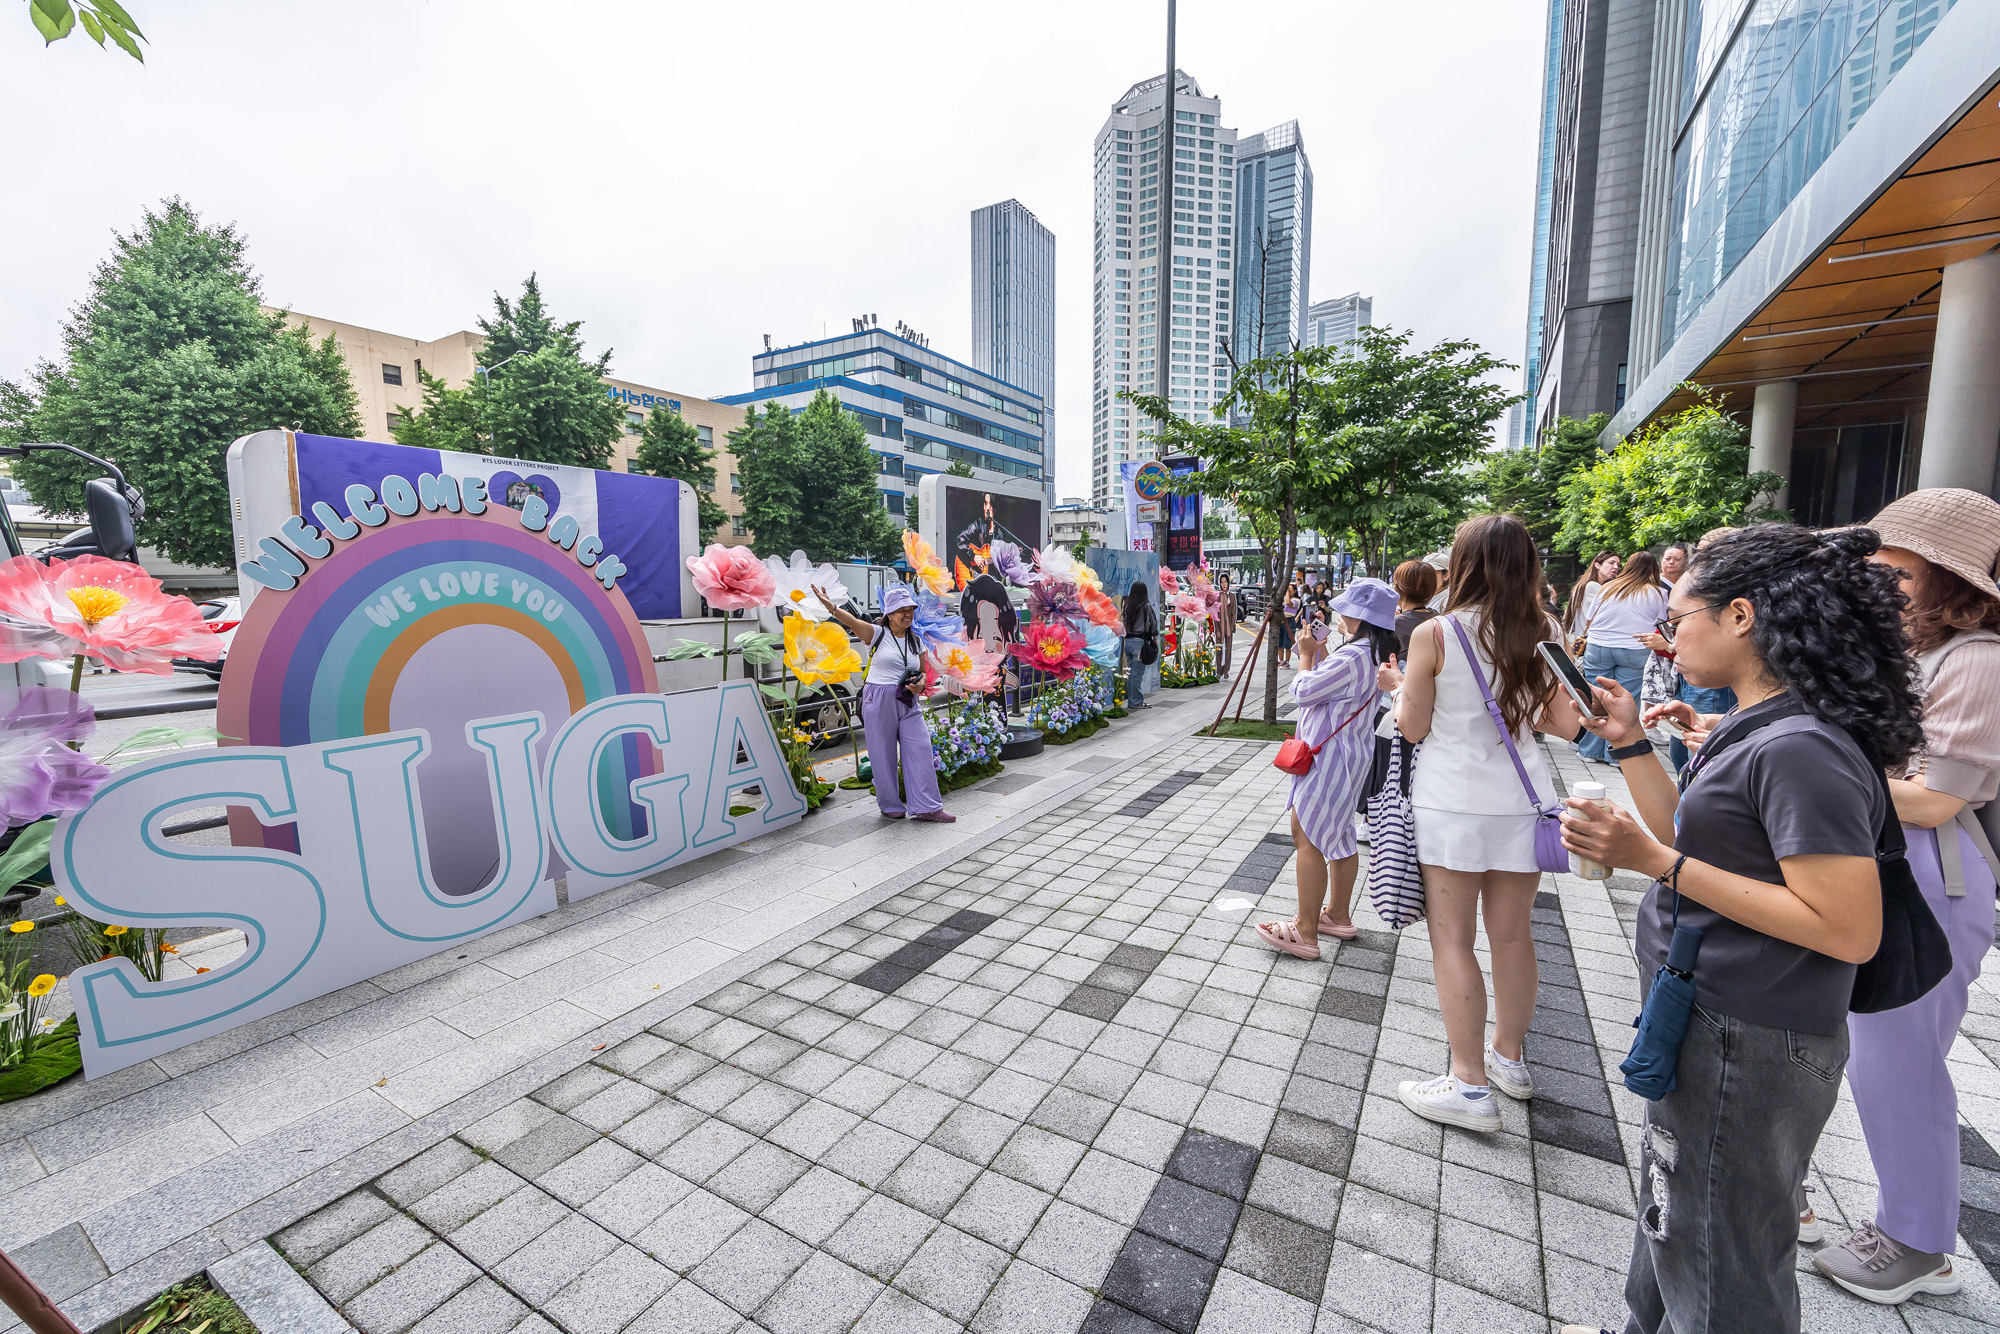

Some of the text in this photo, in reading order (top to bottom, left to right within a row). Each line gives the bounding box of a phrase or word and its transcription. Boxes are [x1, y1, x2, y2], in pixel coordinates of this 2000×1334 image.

[240, 472, 627, 592] WELCOME BACK
[364, 571, 564, 628] WE LOVE YOU
[65, 682, 806, 1048] SUGA
